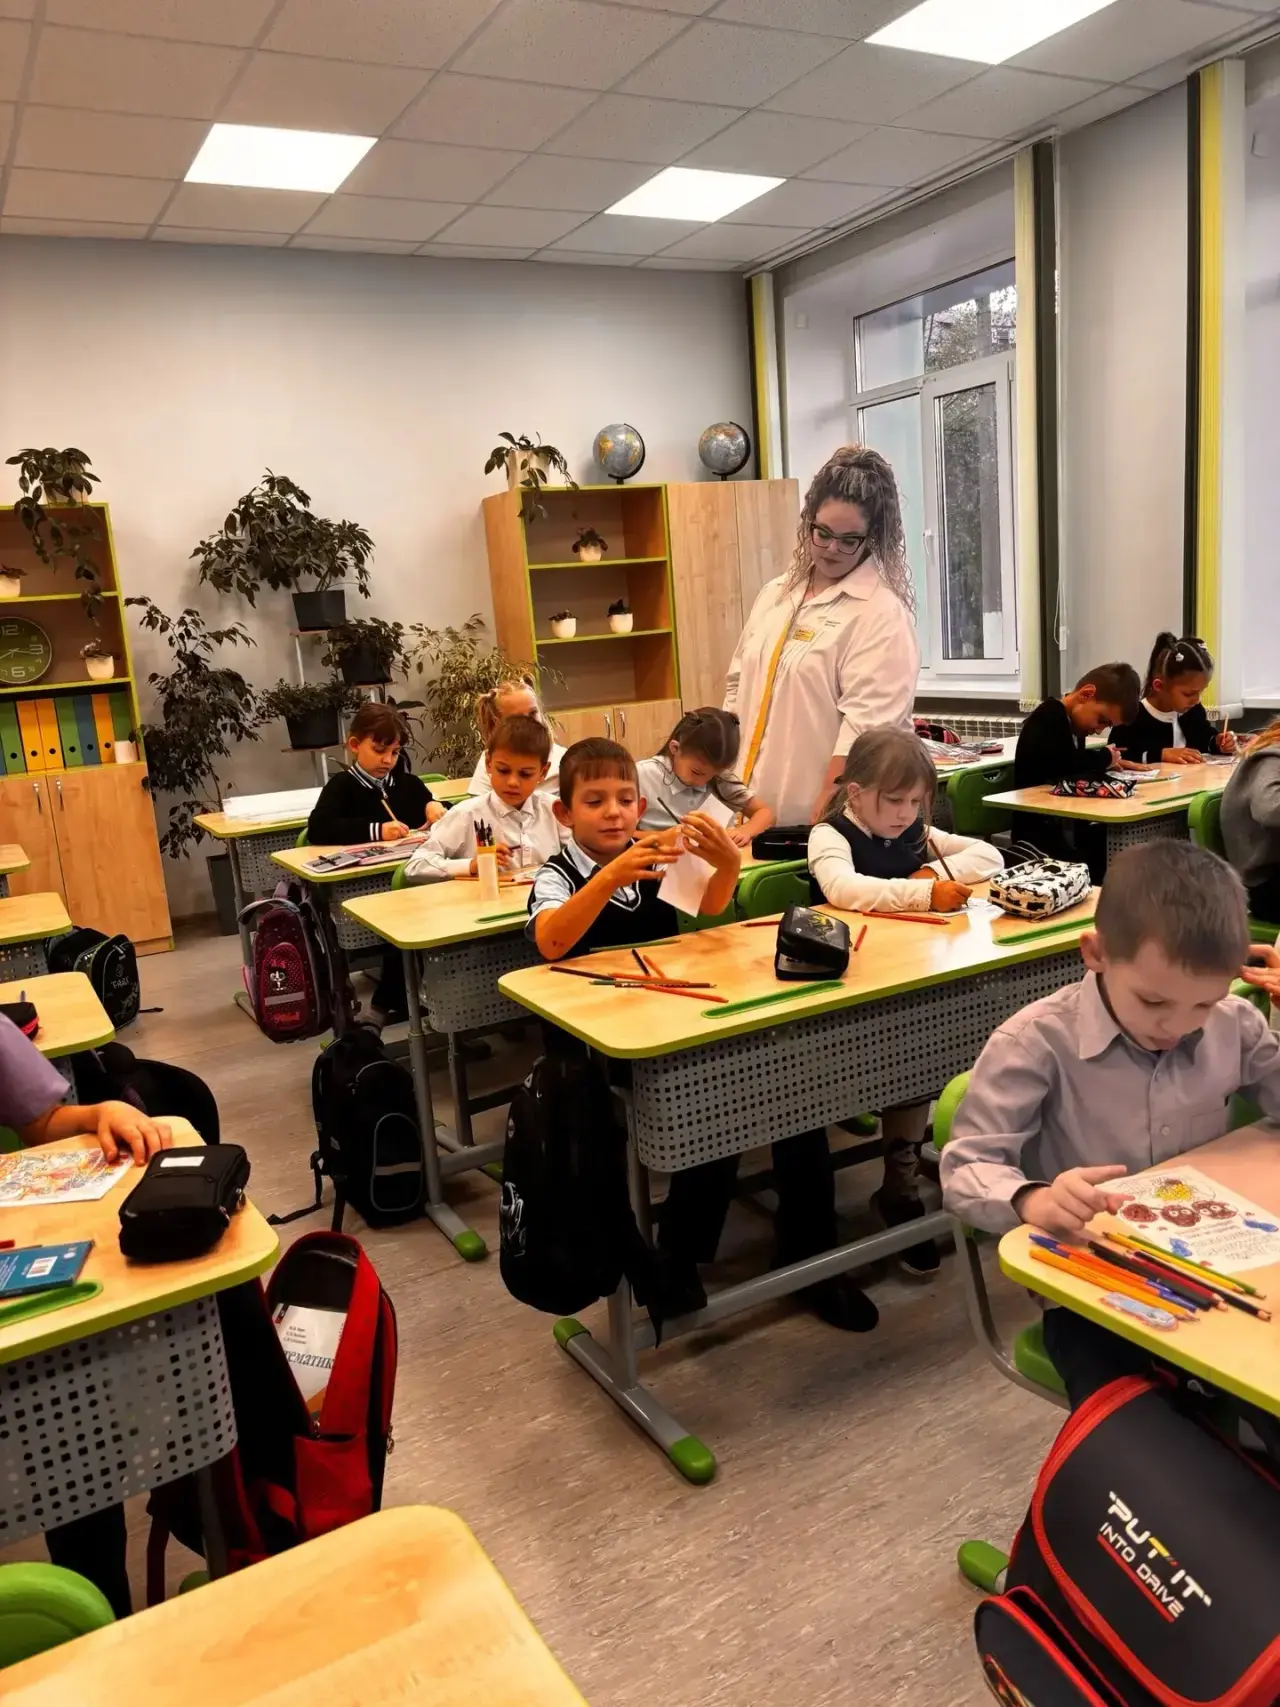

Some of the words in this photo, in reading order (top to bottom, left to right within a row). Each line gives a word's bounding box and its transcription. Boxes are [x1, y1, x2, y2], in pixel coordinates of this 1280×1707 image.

[2, 625, 20, 636] 12
[29, 644, 44, 655] 3
[11, 666, 25, 678] 6
[1108, 1491, 1173, 1562] PUT
[1170, 1569, 1212, 1607] IT
[1099, 1521, 1136, 1563] INTO
[1136, 1562, 1185, 1618] DRIVE
